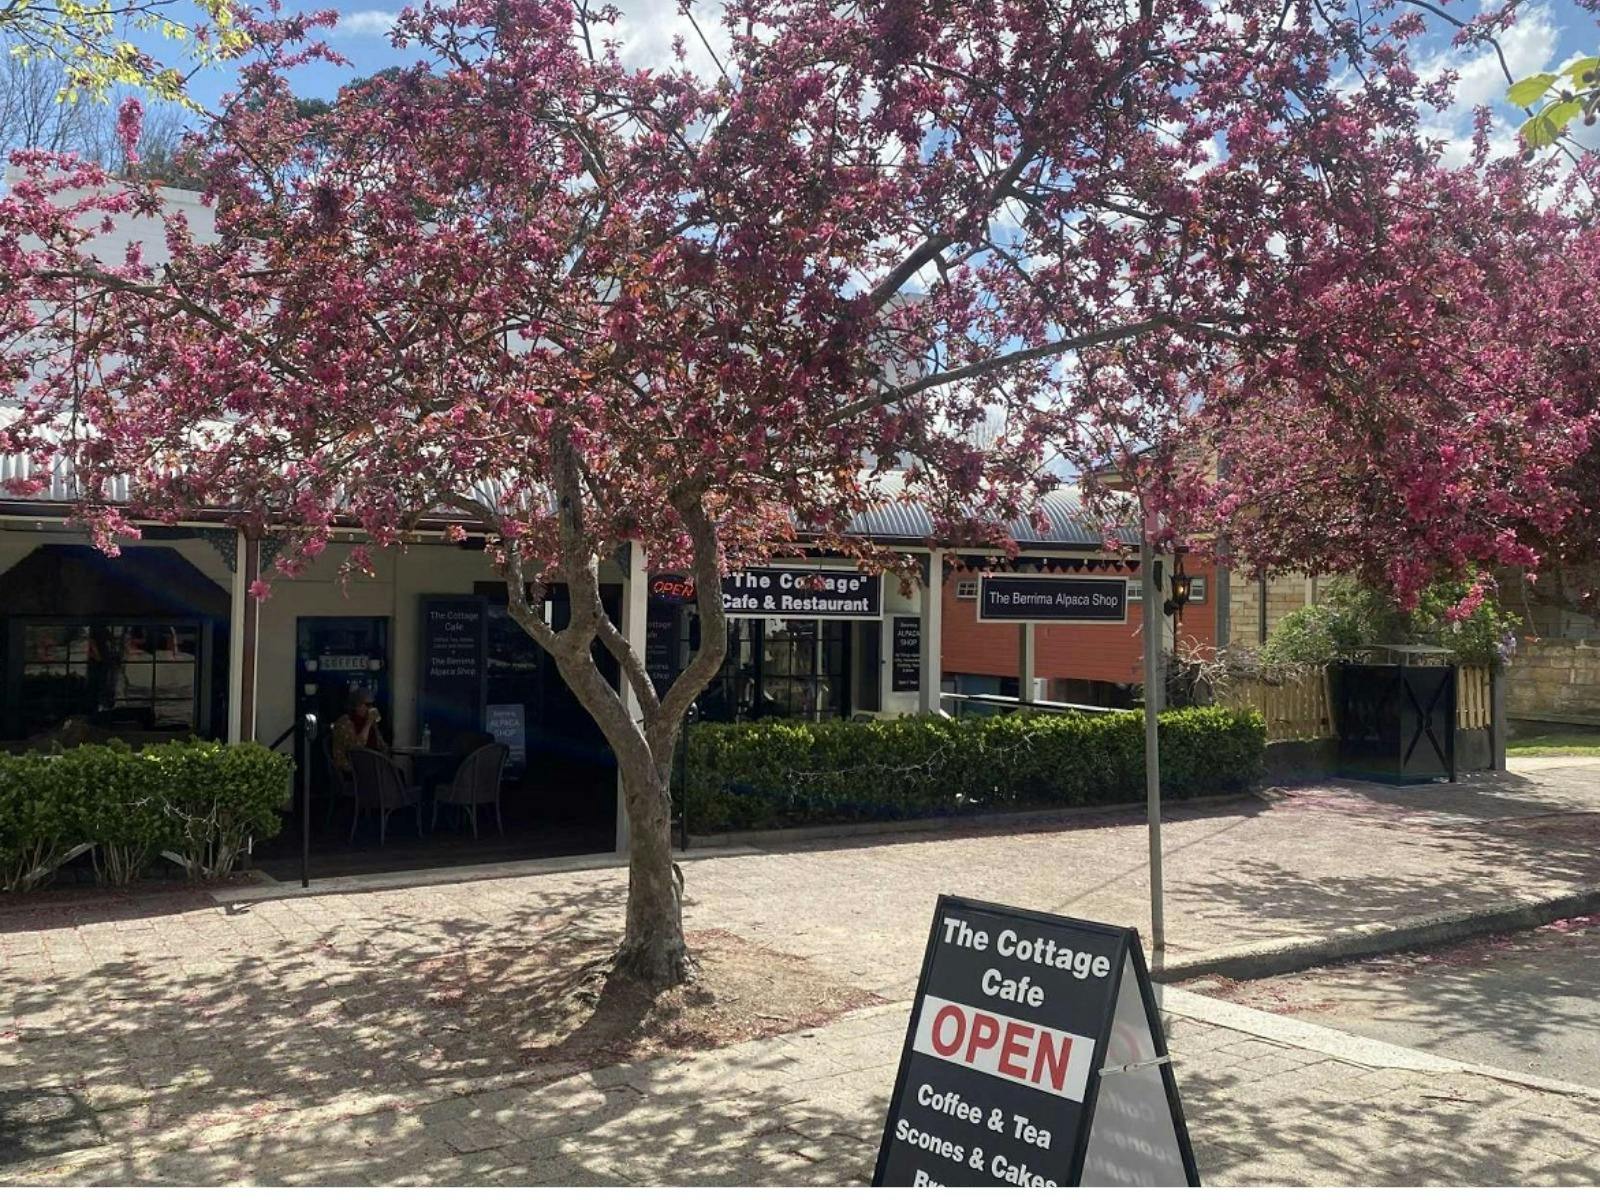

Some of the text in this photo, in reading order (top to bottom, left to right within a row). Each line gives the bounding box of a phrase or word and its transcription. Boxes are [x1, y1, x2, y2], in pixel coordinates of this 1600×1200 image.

[653, 581, 695, 597] OPEN
[779, 573, 867, 593] Coage"
[722, 594, 869, 611] Cafe & Restaurant
[989, 591, 1119, 608] The Berrima Alpaca Shop
[430, 610, 479, 621] The Cottage
[445, 622, 464, 632] Cafe
[432, 656, 445, 665] The
[430, 667, 477, 677] Alpaca Shop
[490, 719, 521, 728] ALPACA
[943, 917, 1111, 979] The Cottage
[981, 968, 1045, 1008] Cafe
[931, 1004, 1073, 1091] OPEN
[917, 1084, 1052, 1150] Coffee & Tea
[895, 1119, 965, 1163] Scones
[969, 1147, 985, 1172] &
